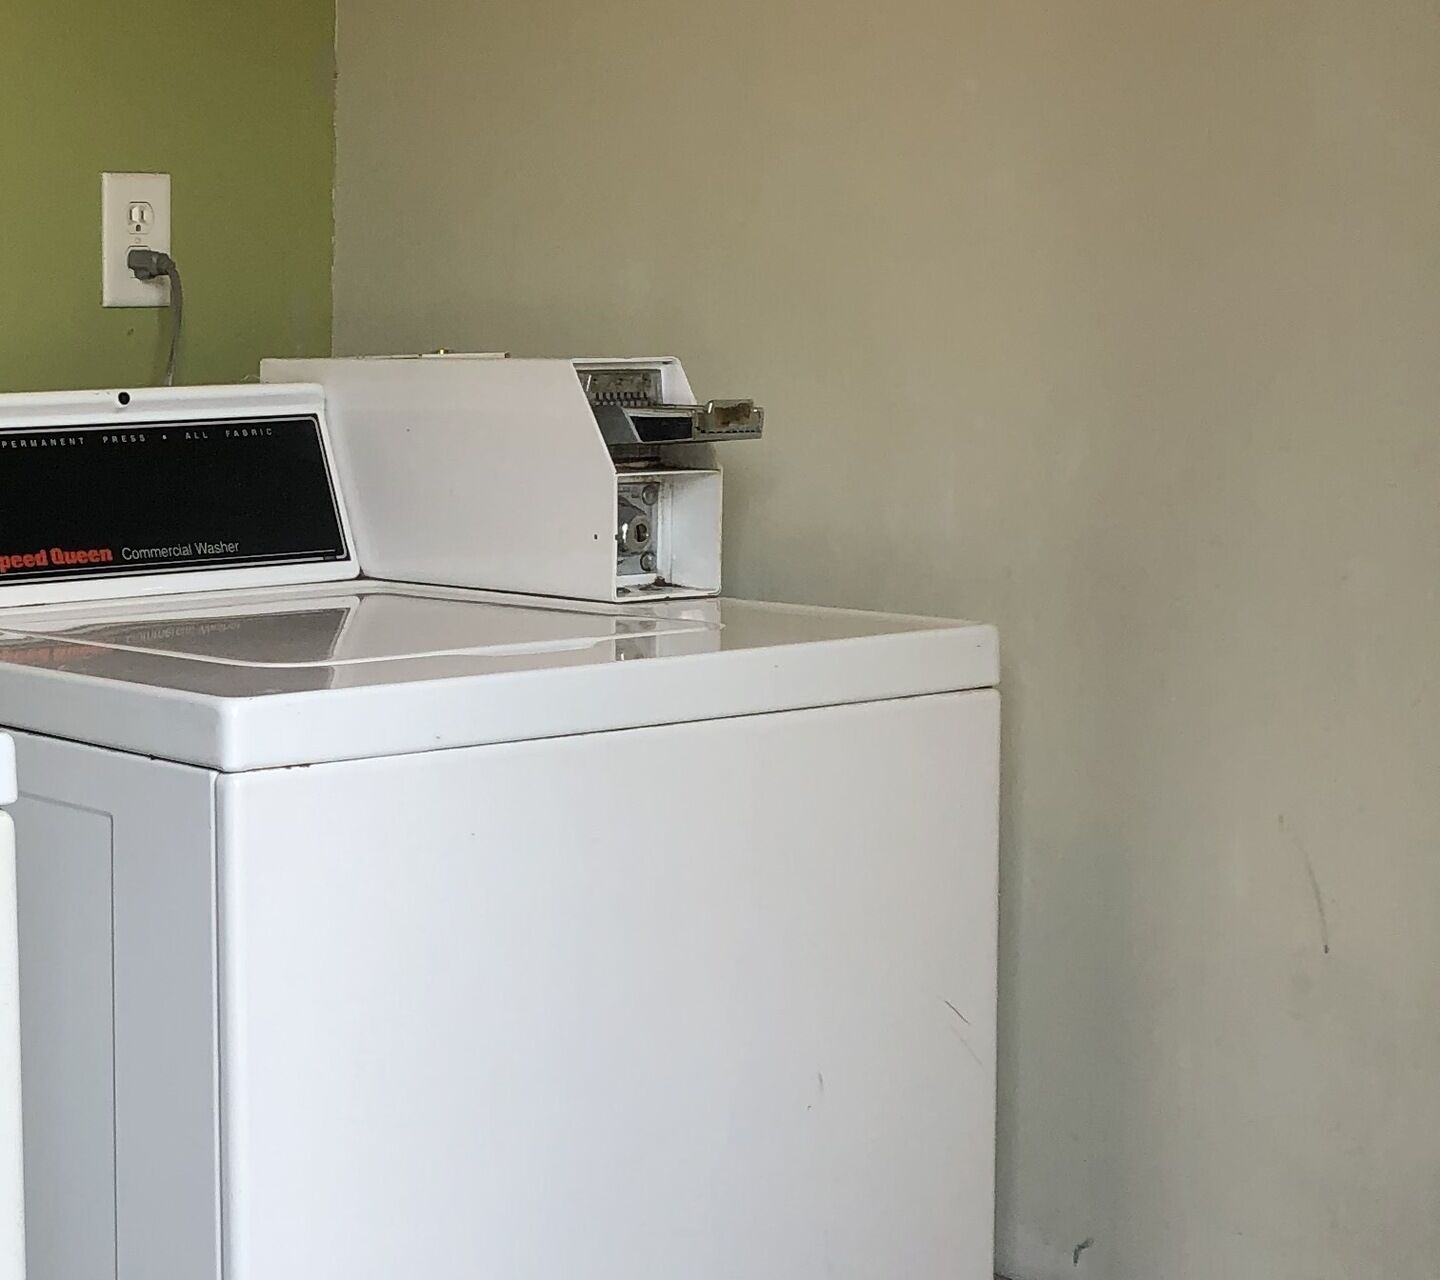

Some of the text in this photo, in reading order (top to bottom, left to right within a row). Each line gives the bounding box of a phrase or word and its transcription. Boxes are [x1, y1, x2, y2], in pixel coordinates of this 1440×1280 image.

[1, 428, 273, 449] PERMANENT PRESS ALL FABRIC
[50, 547, 113, 565] Queen
[121, 543, 192, 560] Commercial
[194, 541, 240, 556] Washer
